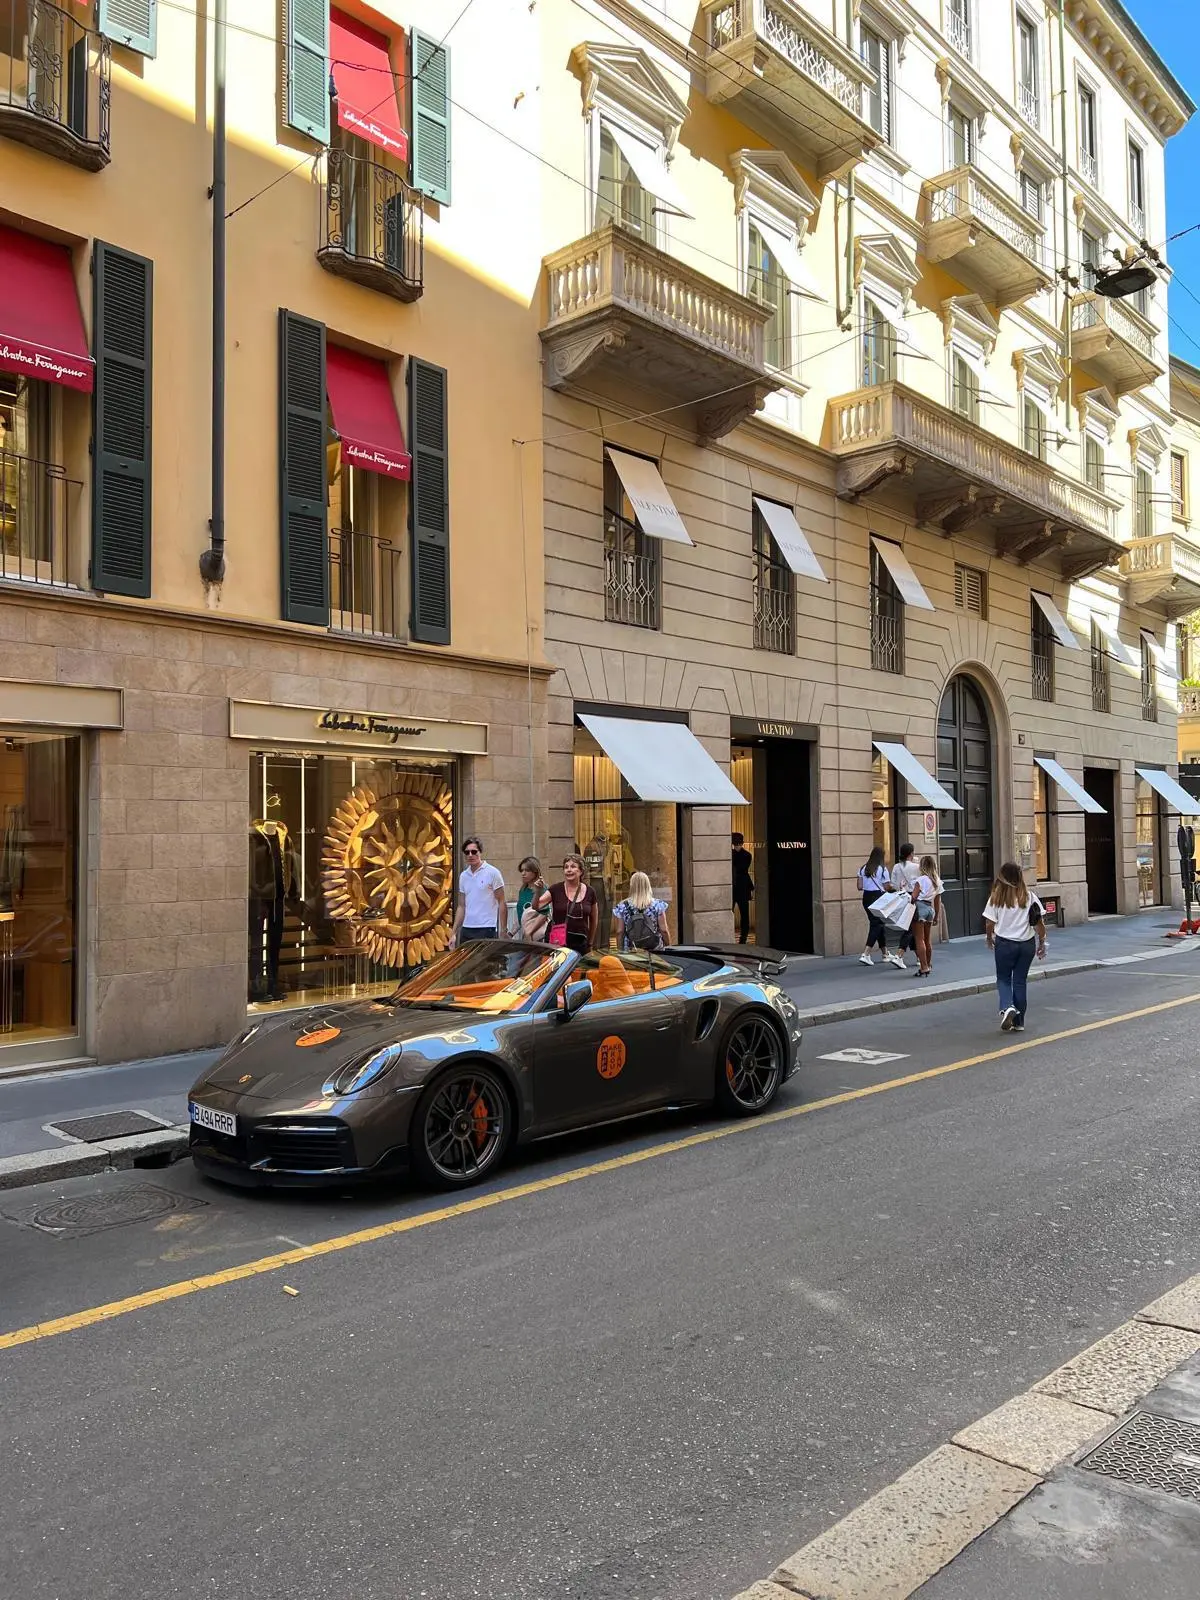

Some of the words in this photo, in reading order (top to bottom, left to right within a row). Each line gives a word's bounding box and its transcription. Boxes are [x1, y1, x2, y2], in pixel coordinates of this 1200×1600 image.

[35, 353, 87, 379] Ferragamo
[346, 445, 375, 461] Salvatore
[373, 452, 407, 471] Ferragamo
[366, 716, 427, 743] Ferragamo
[757, 722, 794, 736] VALENTINO
[776, 841, 807, 849] VALENTINO
